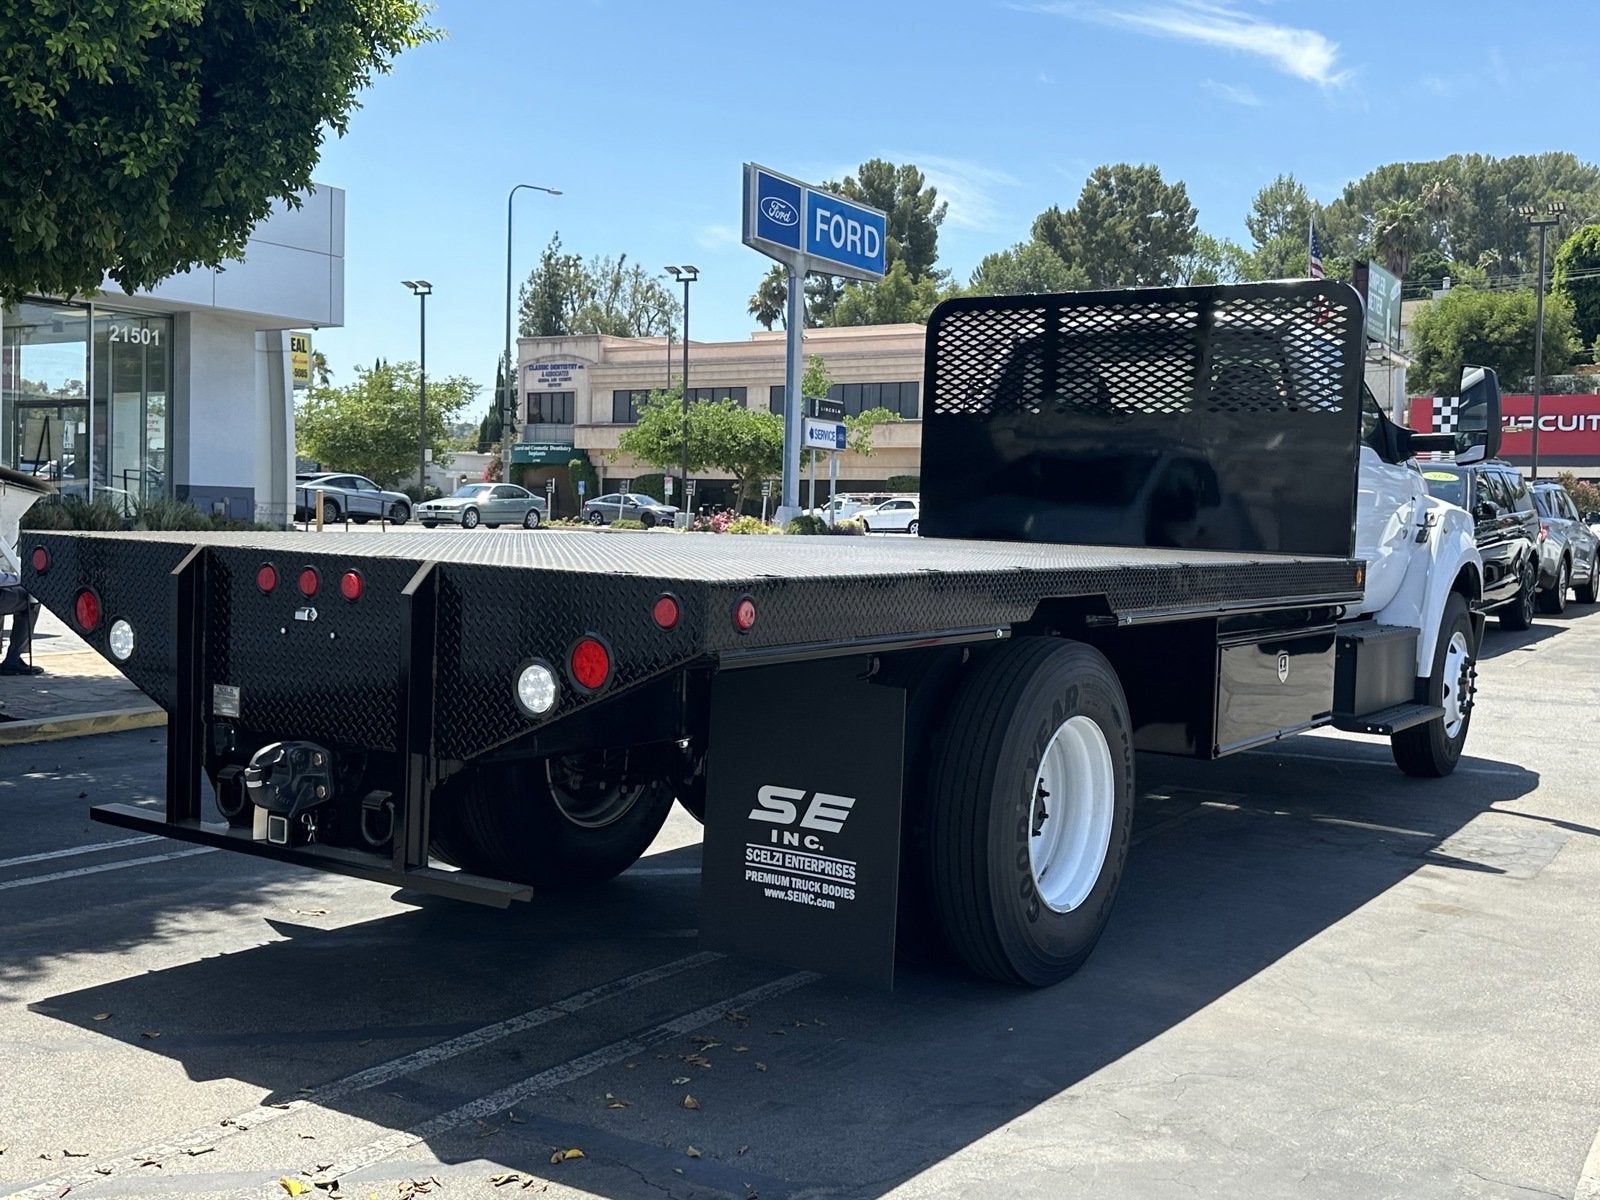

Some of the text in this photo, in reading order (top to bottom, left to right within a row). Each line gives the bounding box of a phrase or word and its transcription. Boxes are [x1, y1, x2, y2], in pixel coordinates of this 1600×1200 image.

[768, 200, 792, 223] Ford
[815, 207, 880, 258] FORD
[109, 325, 160, 346] 21501
[291, 337, 307, 353] EAL
[814, 428, 836, 442] SERVICE
[748, 785, 856, 834] SE
[771, 829, 824, 851] INC.
[745, 848, 856, 880] SCELZI ENTERPRISES
[745, 869, 856, 900] PREMIUM TRUCK BODIES
[764, 887, 836, 909] www.SEINC.com
